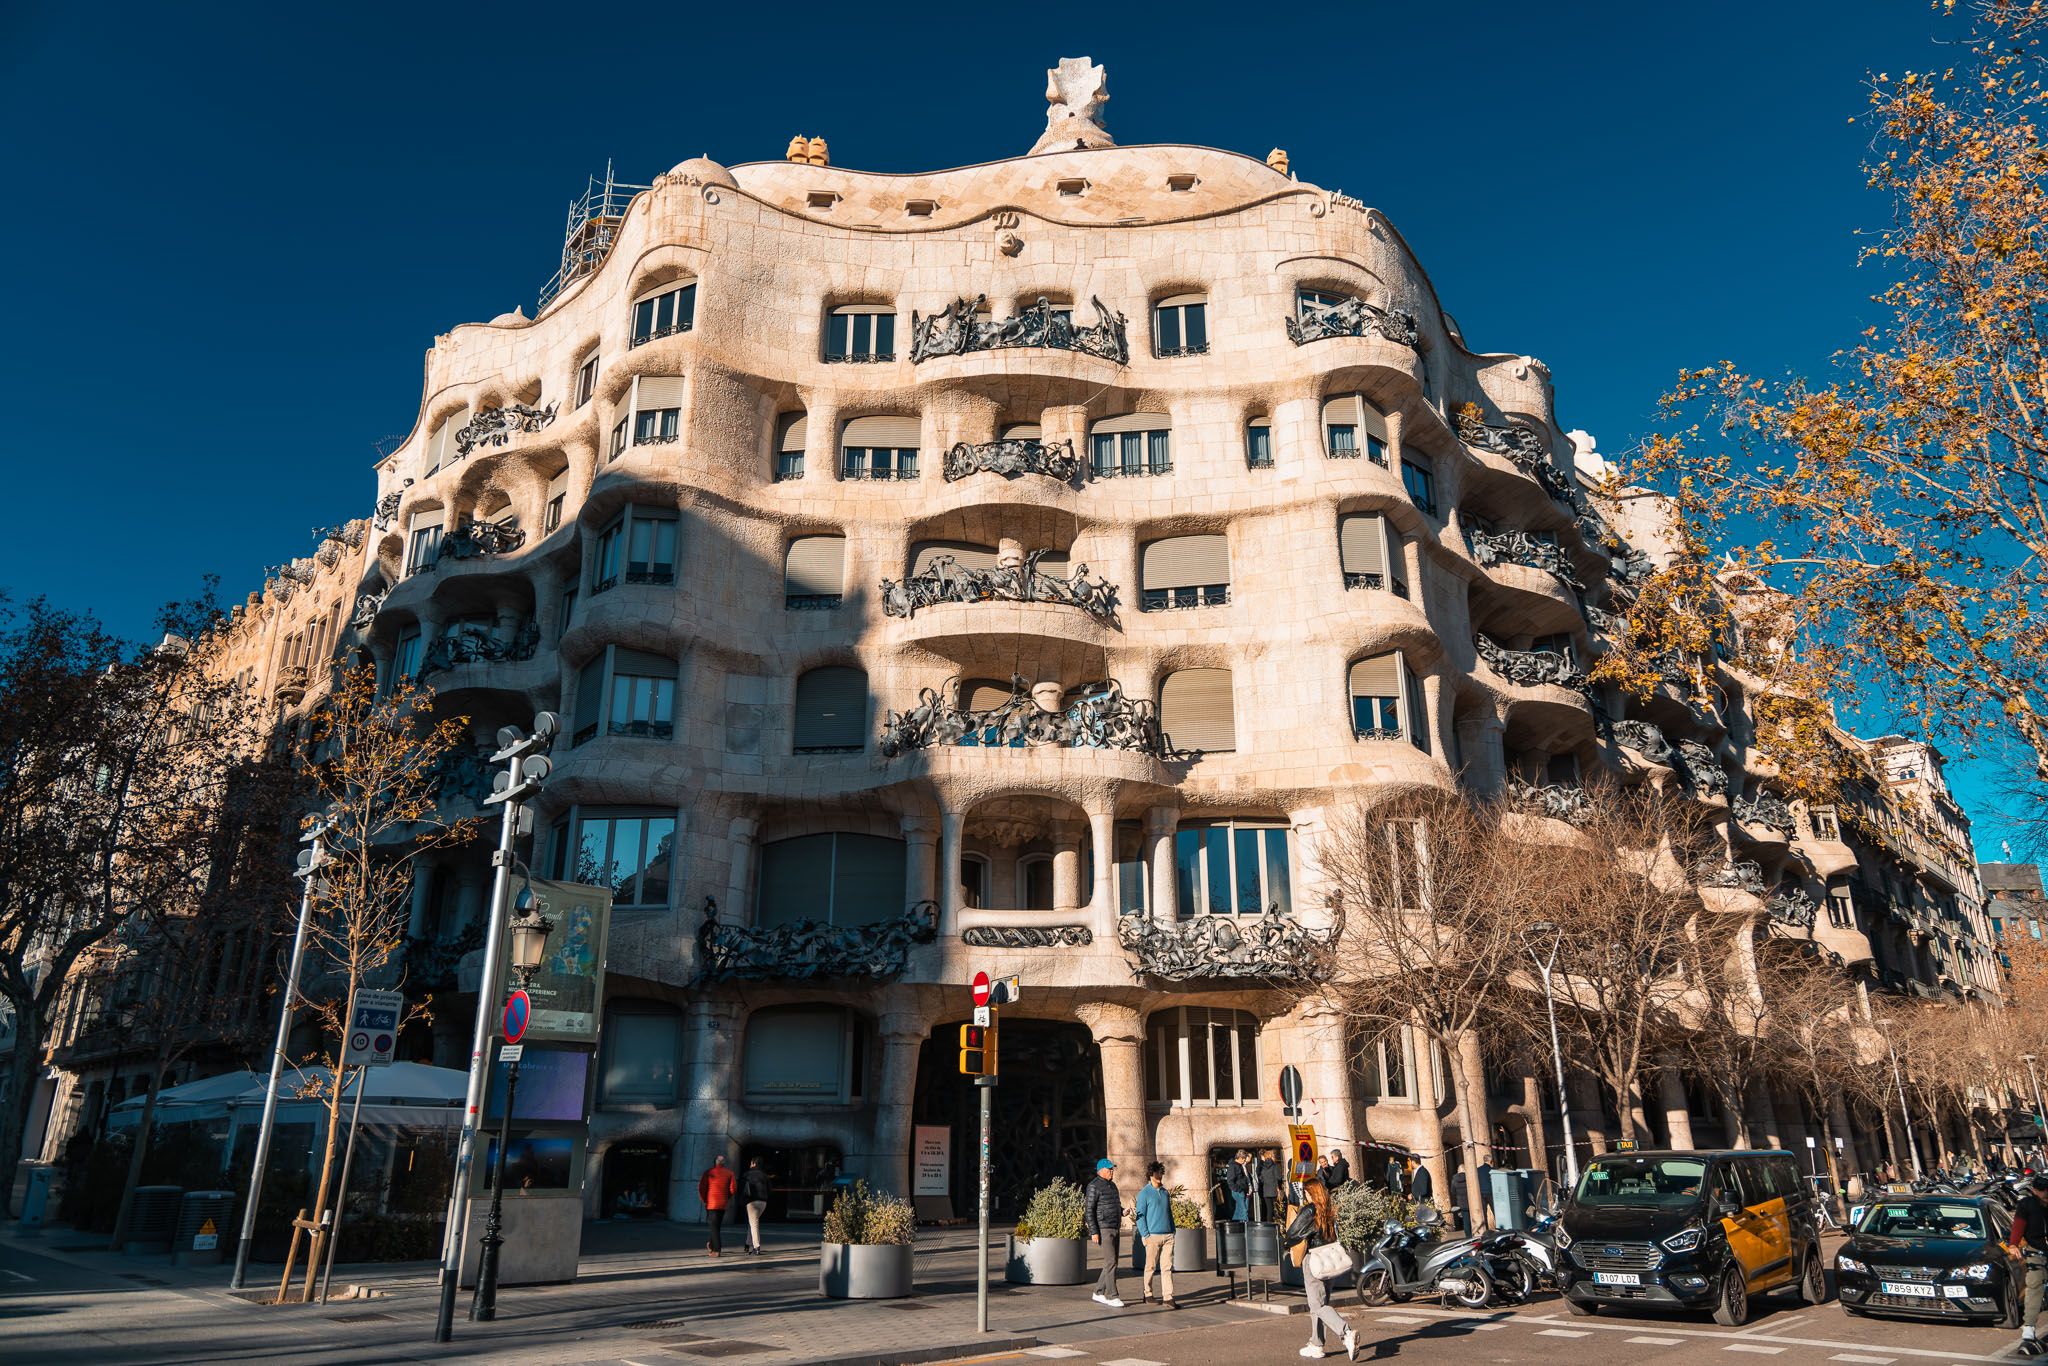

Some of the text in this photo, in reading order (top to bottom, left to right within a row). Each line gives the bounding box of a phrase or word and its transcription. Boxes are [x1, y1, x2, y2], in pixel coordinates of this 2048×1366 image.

[1621, 1141, 1633, 1149] TAXI
[1893, 1185, 1905, 1193] TAXI
[1600, 1274, 1619, 1283] 8107
[1888, 1284, 1932, 1295] 7859 KYZ
